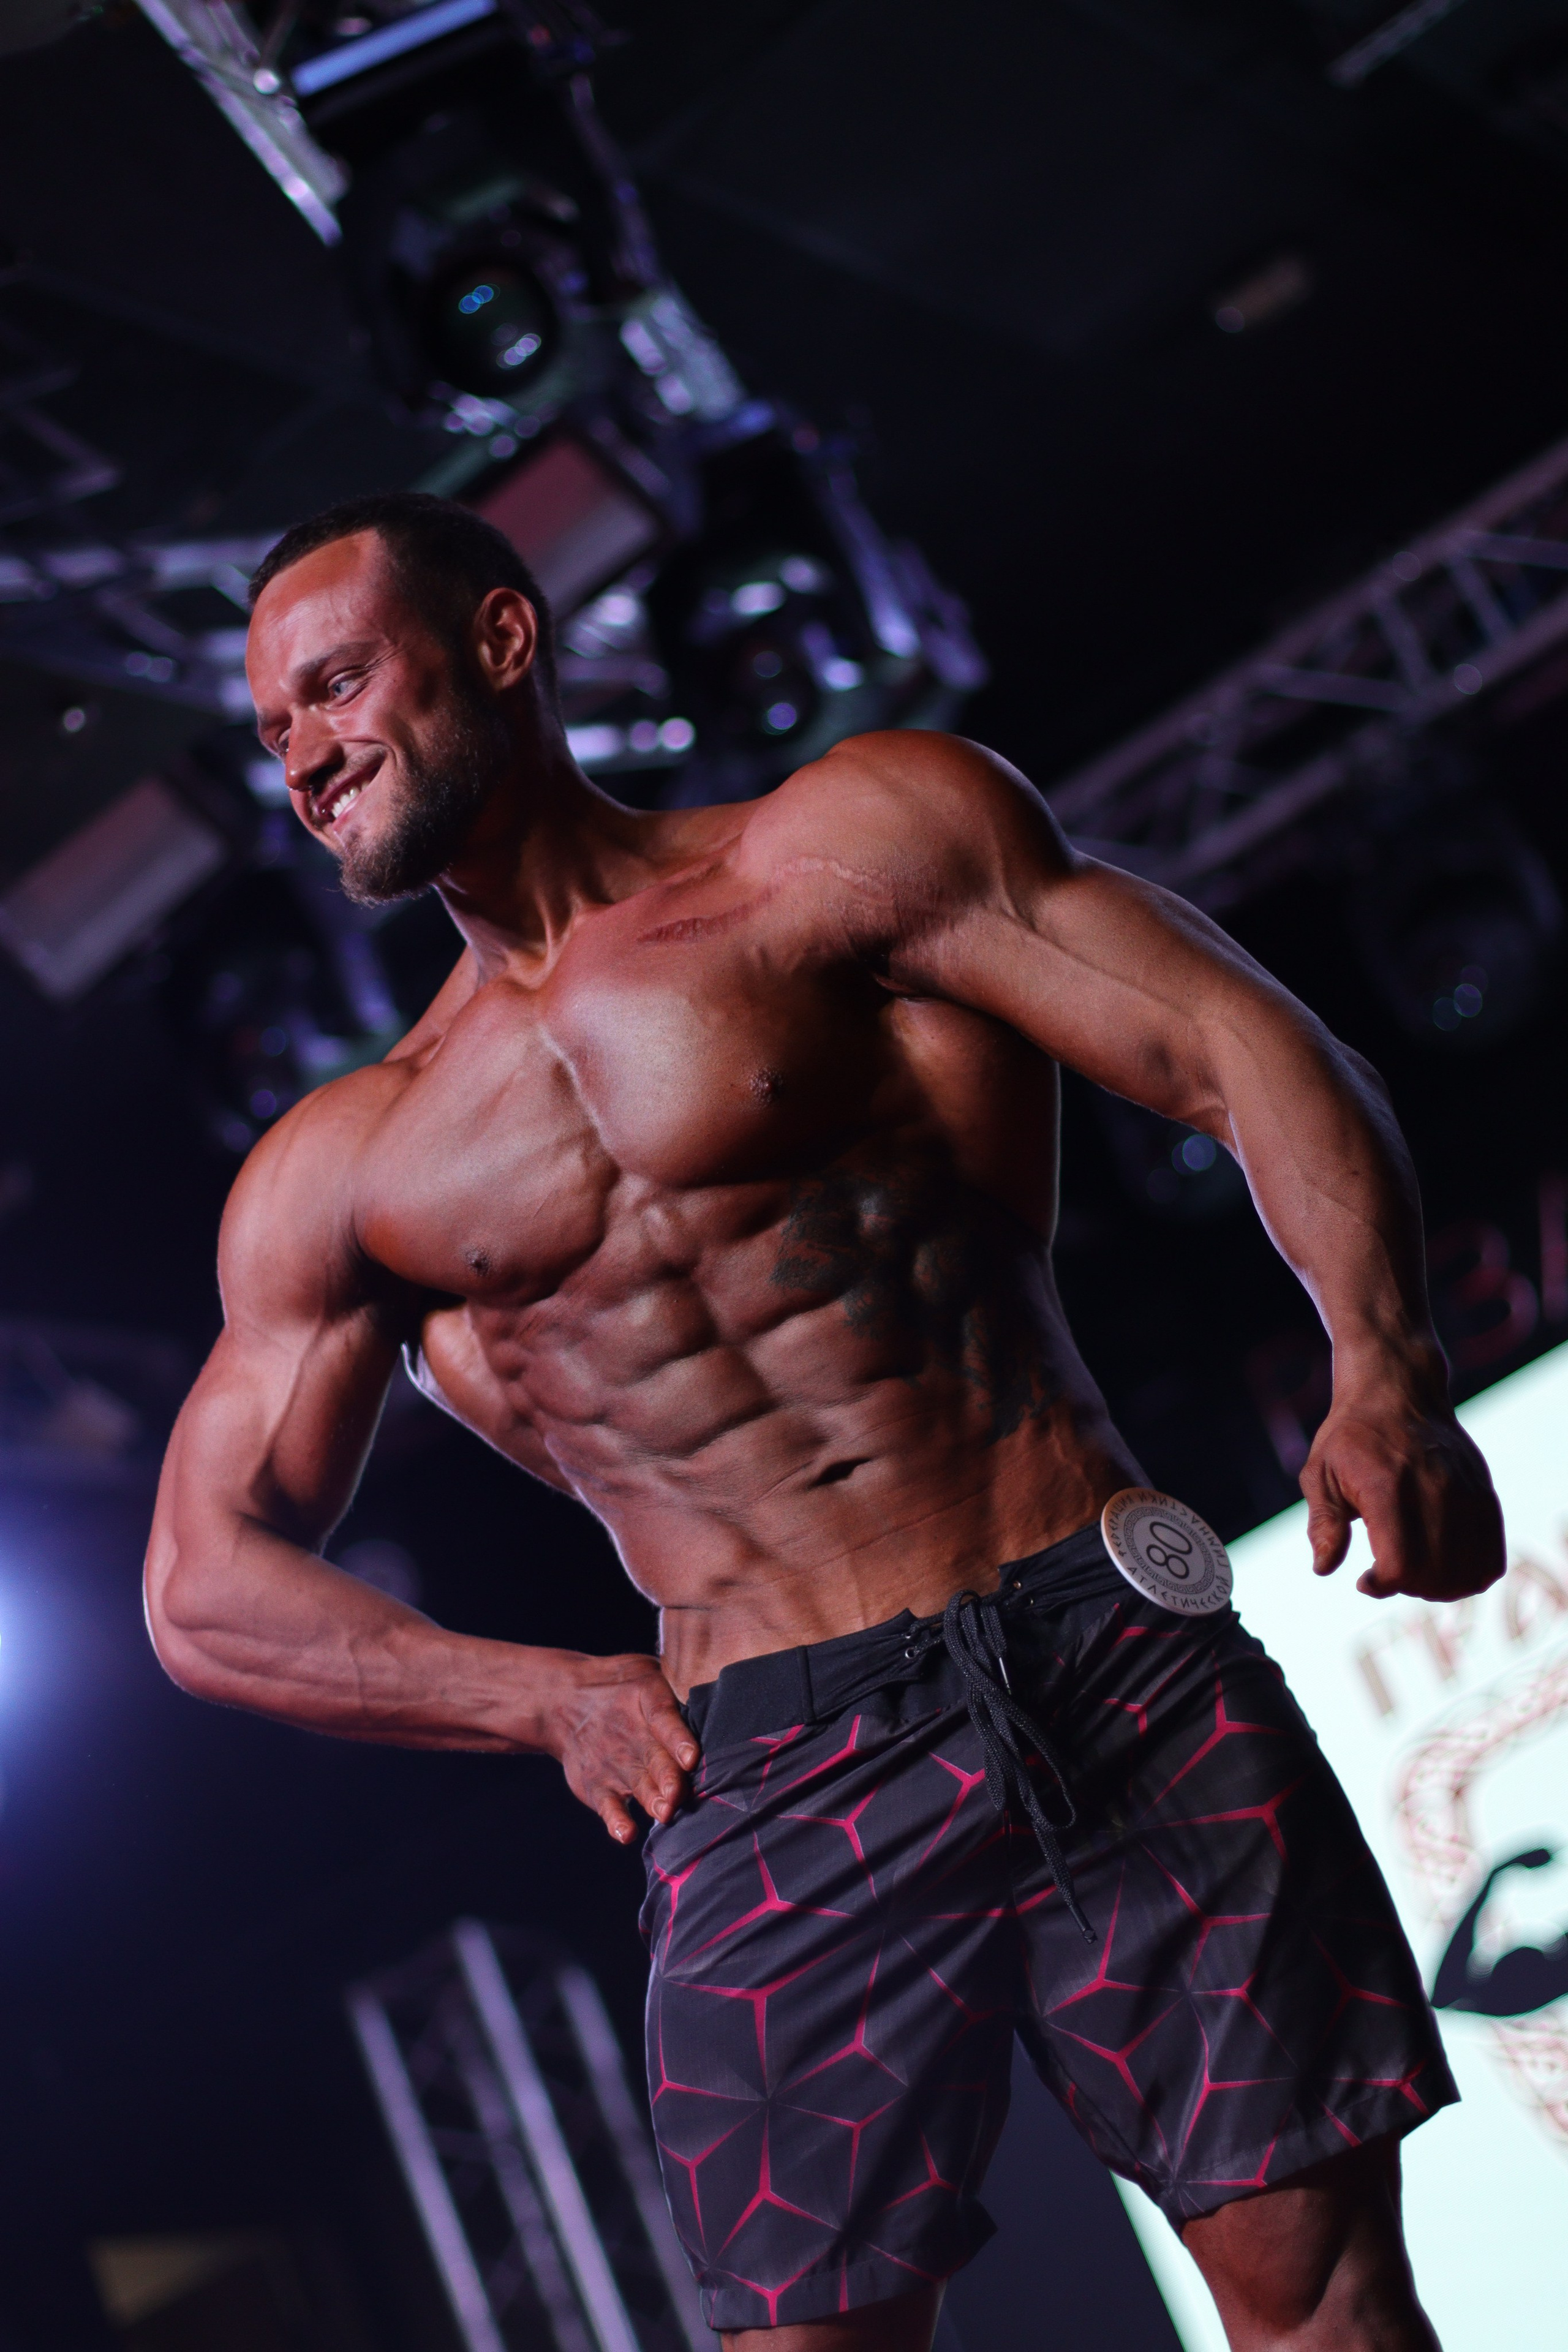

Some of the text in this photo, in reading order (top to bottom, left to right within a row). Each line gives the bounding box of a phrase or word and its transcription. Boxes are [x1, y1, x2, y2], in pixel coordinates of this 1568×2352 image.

[1109, 1493, 1134, 1557] ФЕДЕРАЦИЯ
[1128, 1566, 1230, 1609] АТЛЕТИЧЕСКОЙ
[1146, 1521, 1193, 1580] 80
